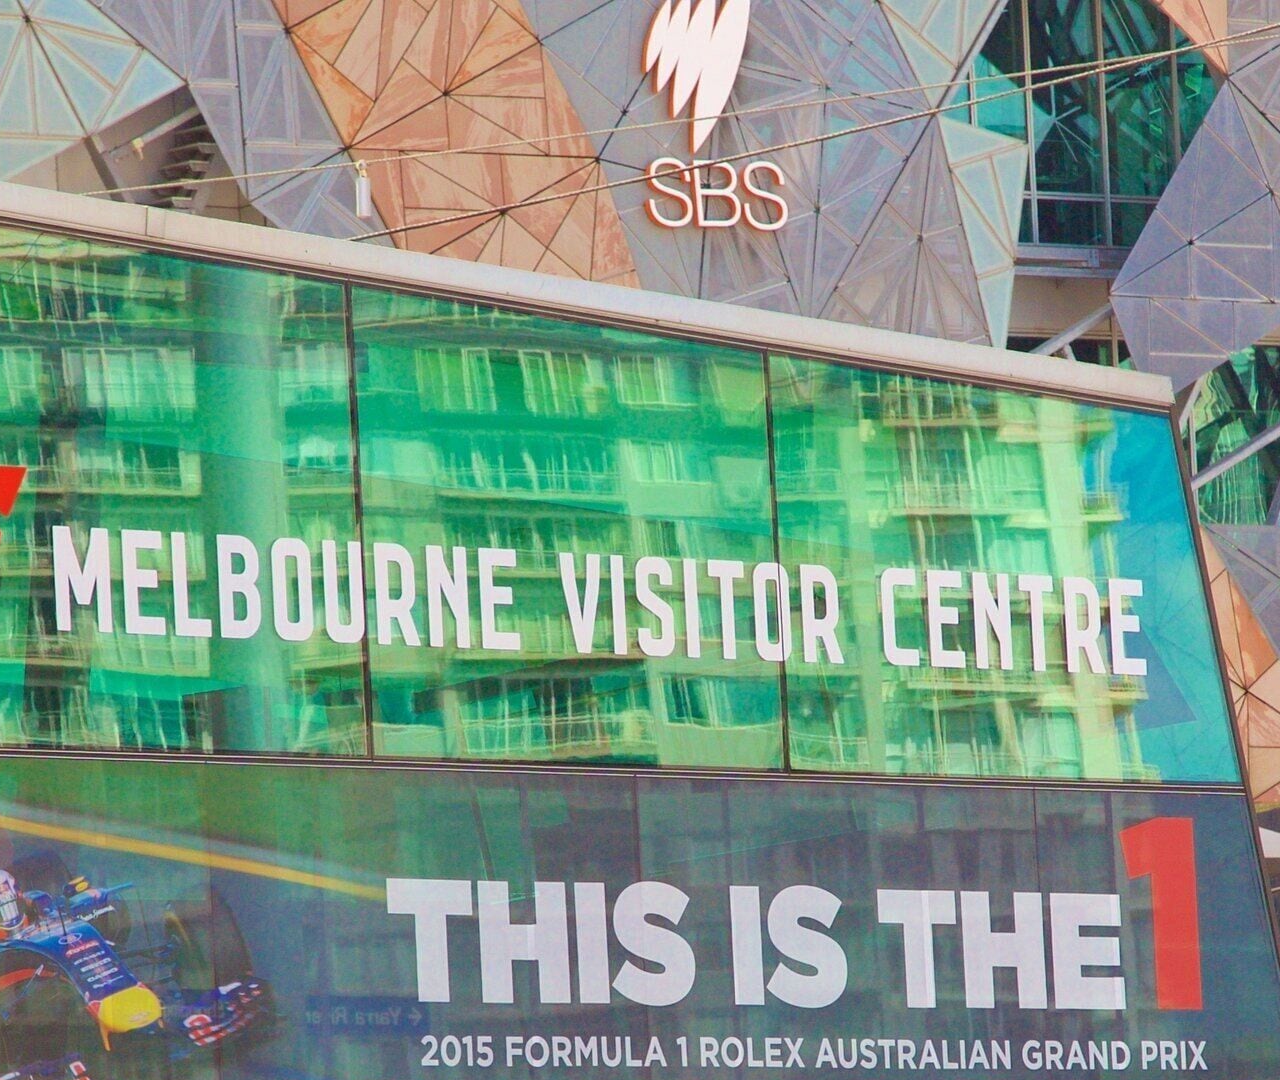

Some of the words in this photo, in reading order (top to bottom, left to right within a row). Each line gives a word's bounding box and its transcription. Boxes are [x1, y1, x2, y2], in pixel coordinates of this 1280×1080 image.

[644, 157, 789, 232] SBS
[52, 525, 521, 652] MELBOURNE
[558, 551, 845, 665] VISITOR
[880, 567, 1148, 676] CENTRE
[386, 877, 697, 1007] THIS
[729, 884, 848, 1009] IS
[876, 888, 1127, 1010] THE
[1119, 816, 1203, 1011] 1
[420, 1034, 494, 1068] 2015
[505, 1036, 668, 1068] FORMULA
[675, 1036, 689, 1067] 1
[699, 1036, 805, 1069] ROLEX
[815, 1037, 1012, 1070] AUSTRALIAN
[1021, 1039, 1132, 1071] GRAND
[1141, 1040, 1209, 1071] PRIX
